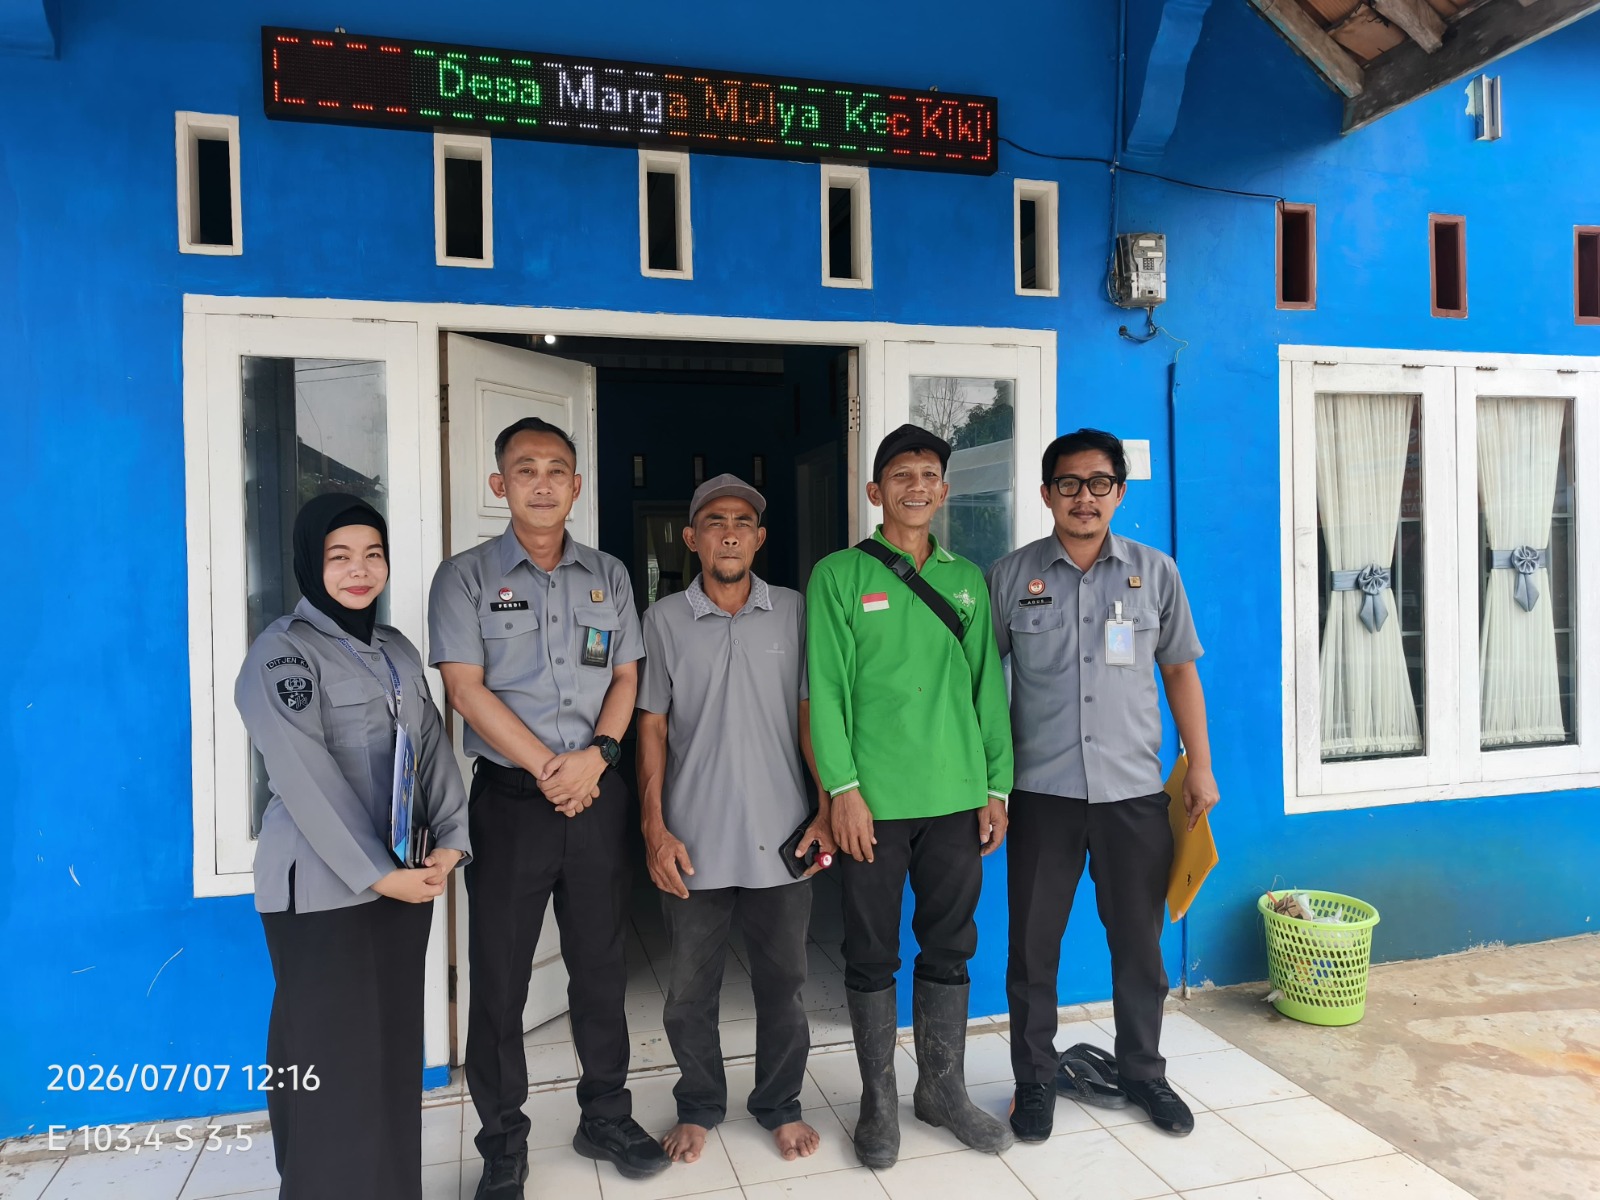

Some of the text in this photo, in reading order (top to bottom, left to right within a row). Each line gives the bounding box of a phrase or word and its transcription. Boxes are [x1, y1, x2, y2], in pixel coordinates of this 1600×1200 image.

[438, 58, 983, 143] Desa Marga Mulya Kec Kiki
